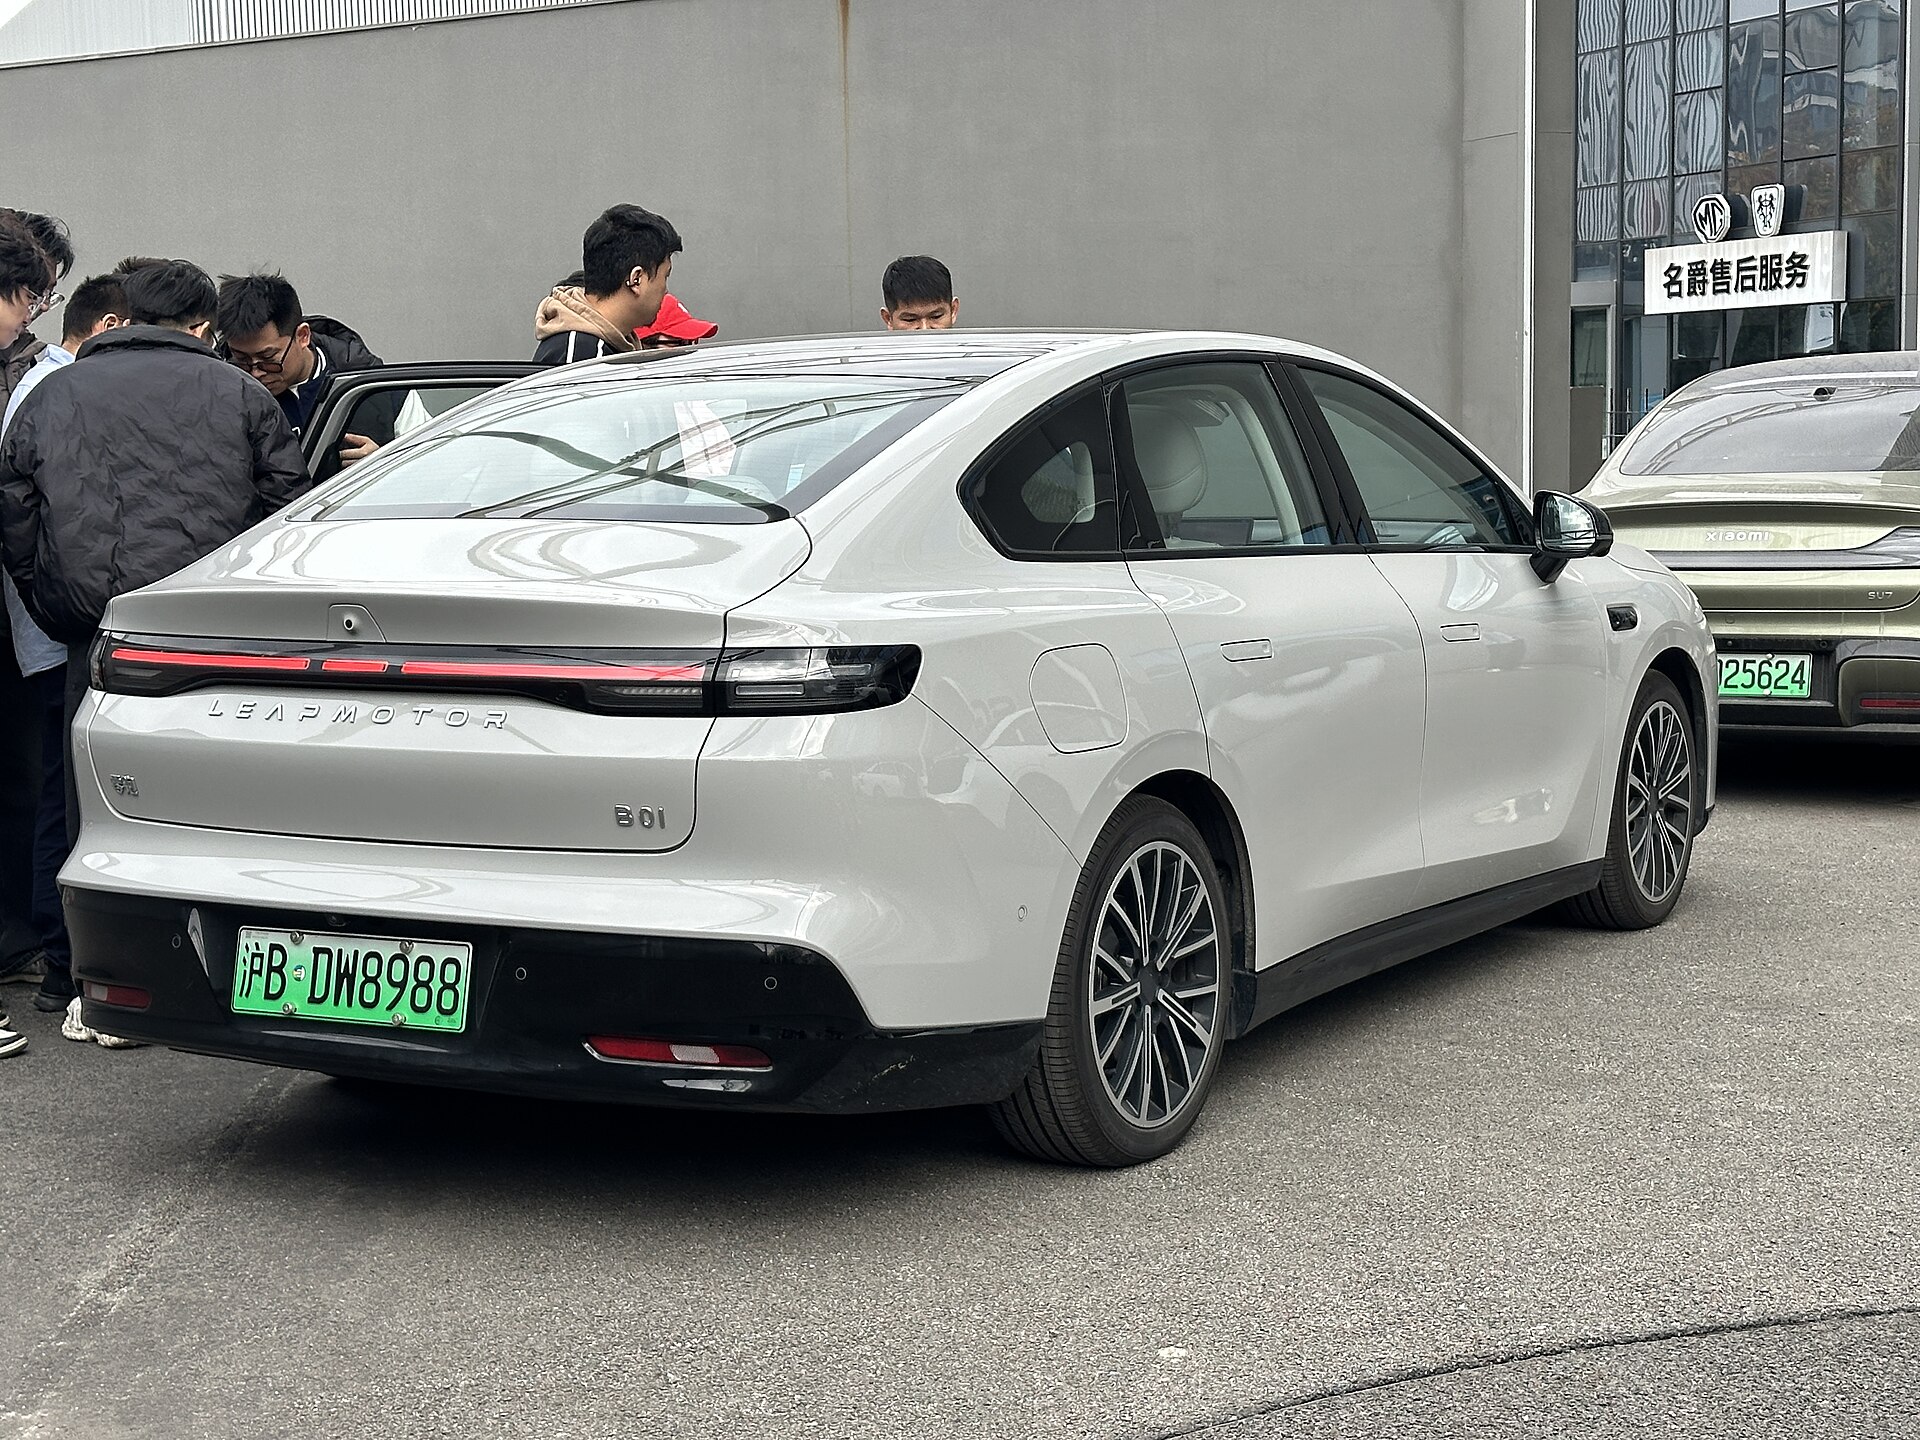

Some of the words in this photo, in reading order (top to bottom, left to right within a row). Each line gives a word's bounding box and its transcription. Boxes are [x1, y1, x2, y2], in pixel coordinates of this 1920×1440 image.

[1662, 251, 1810, 298] 名爵售后服务
[1705, 530, 1770, 543] xiaomi
[1867, 591, 1893, 600] SU7
[207, 697, 508, 729] LEAPMOTOR
